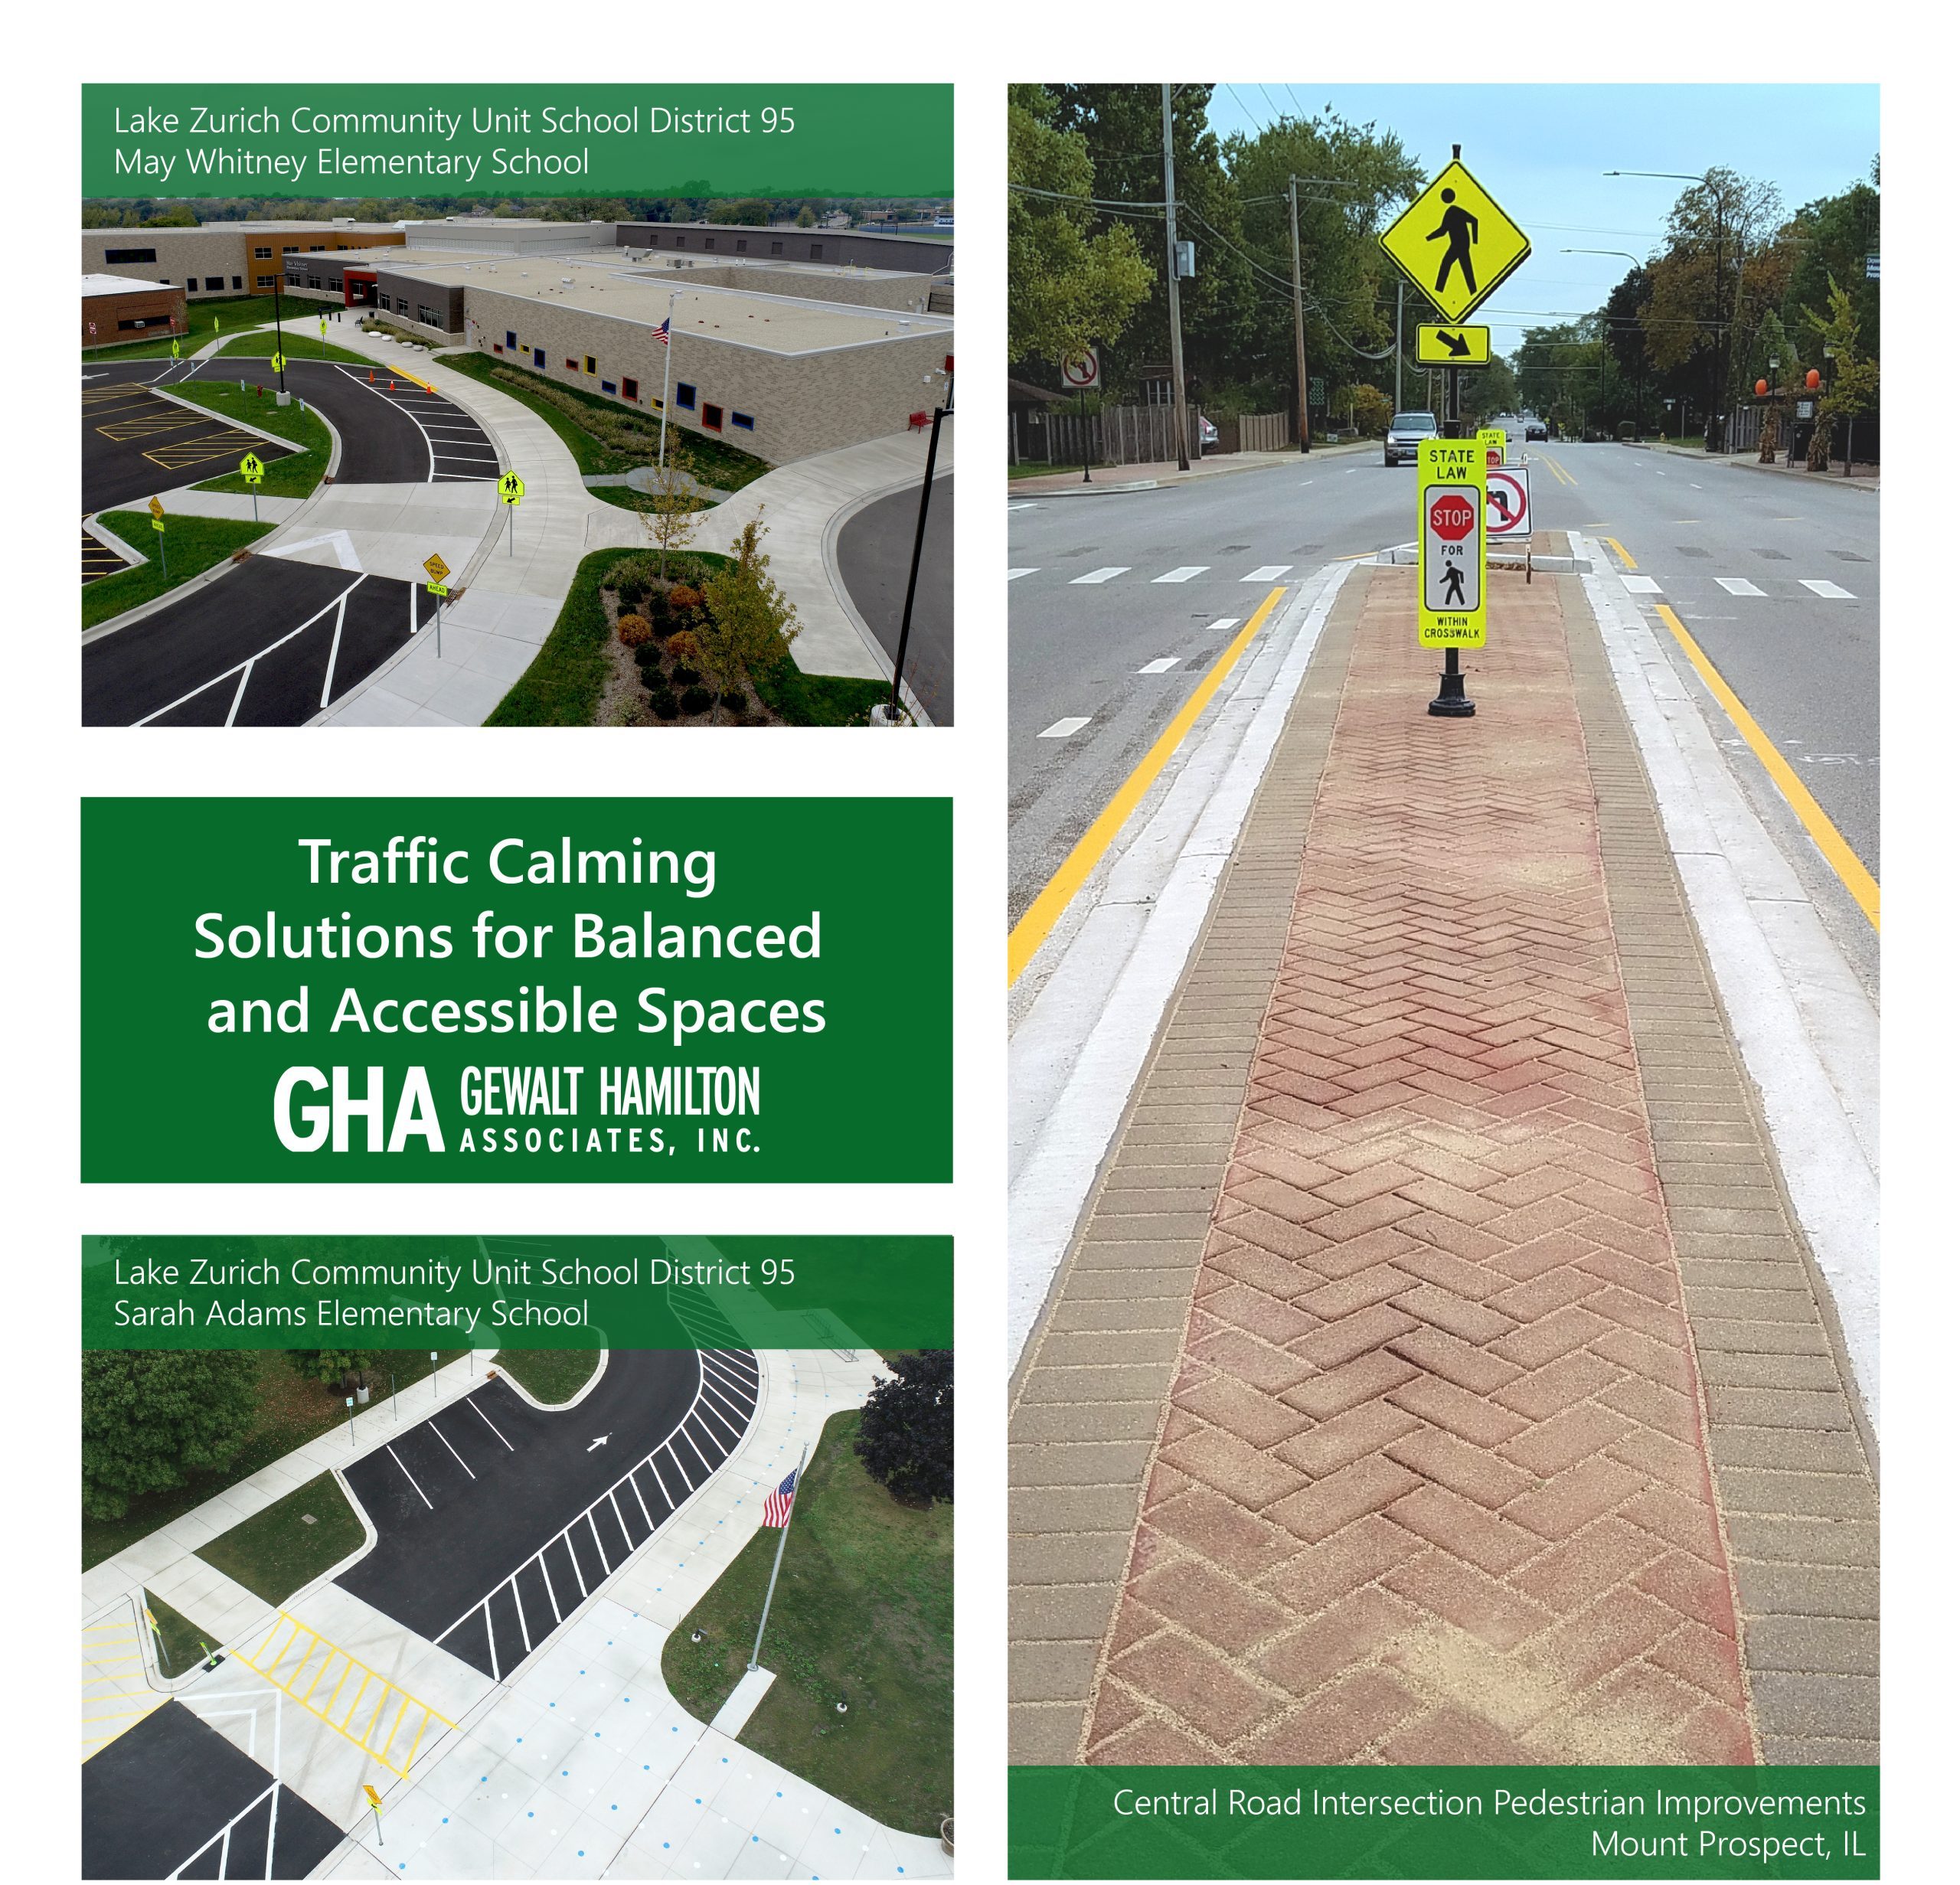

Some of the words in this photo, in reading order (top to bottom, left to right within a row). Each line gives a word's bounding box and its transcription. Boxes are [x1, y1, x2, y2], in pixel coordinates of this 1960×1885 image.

[1429, 449, 1475, 463] STATE
[1437, 466, 1467, 479] LAW
[1432, 509, 1472, 527] STOP
[1441, 545, 1464, 556] FOR
[1436, 616, 1468, 626] WITHIN
[1424, 628, 1480, 639] CROSSWALK
